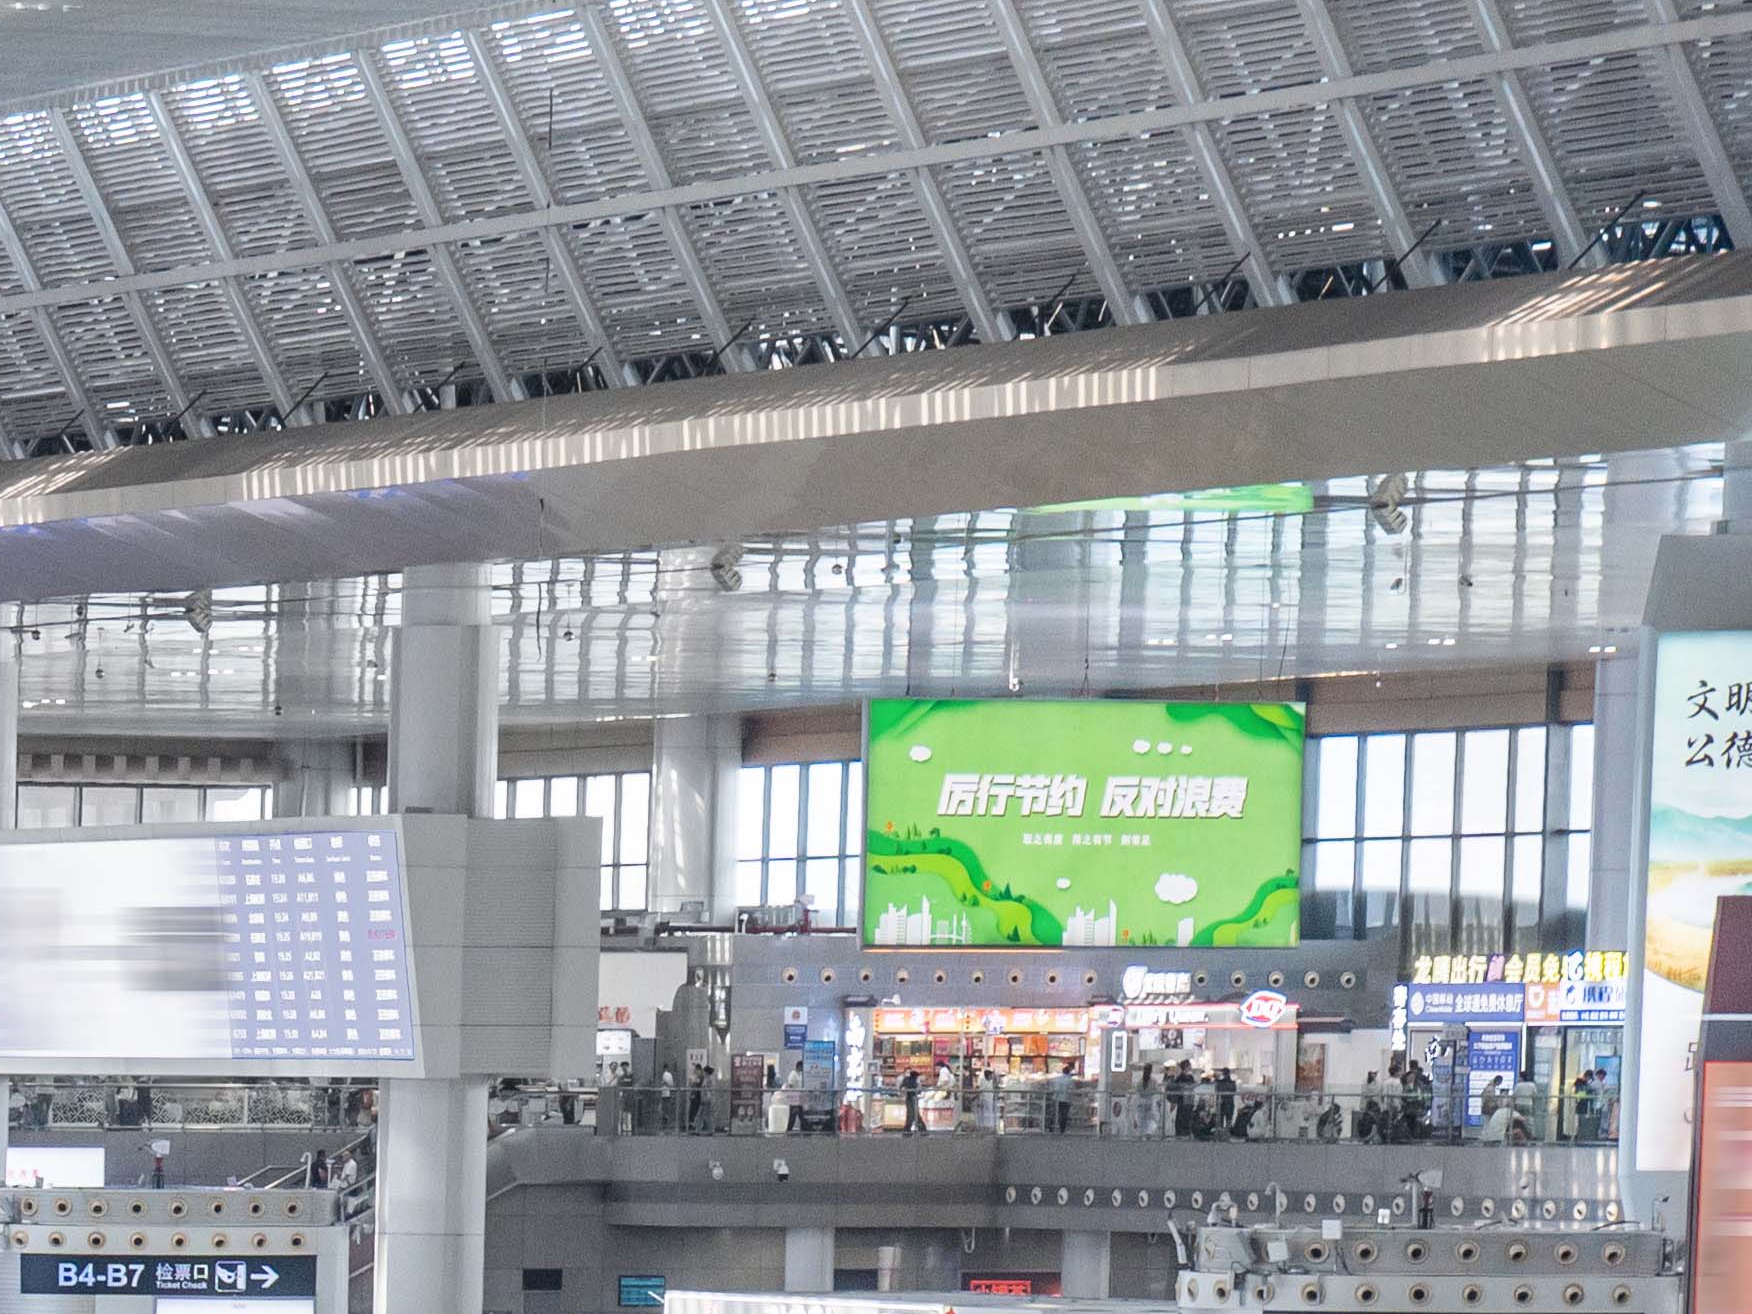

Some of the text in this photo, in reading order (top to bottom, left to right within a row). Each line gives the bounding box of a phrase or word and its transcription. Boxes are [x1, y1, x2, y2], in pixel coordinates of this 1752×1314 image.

[937, 774, 1249, 819] 厉行节约 反对浪费
[58, 1262, 209, 1288] B4-B7 检票口
[156, 1281, 208, 1290] Ticket Check
